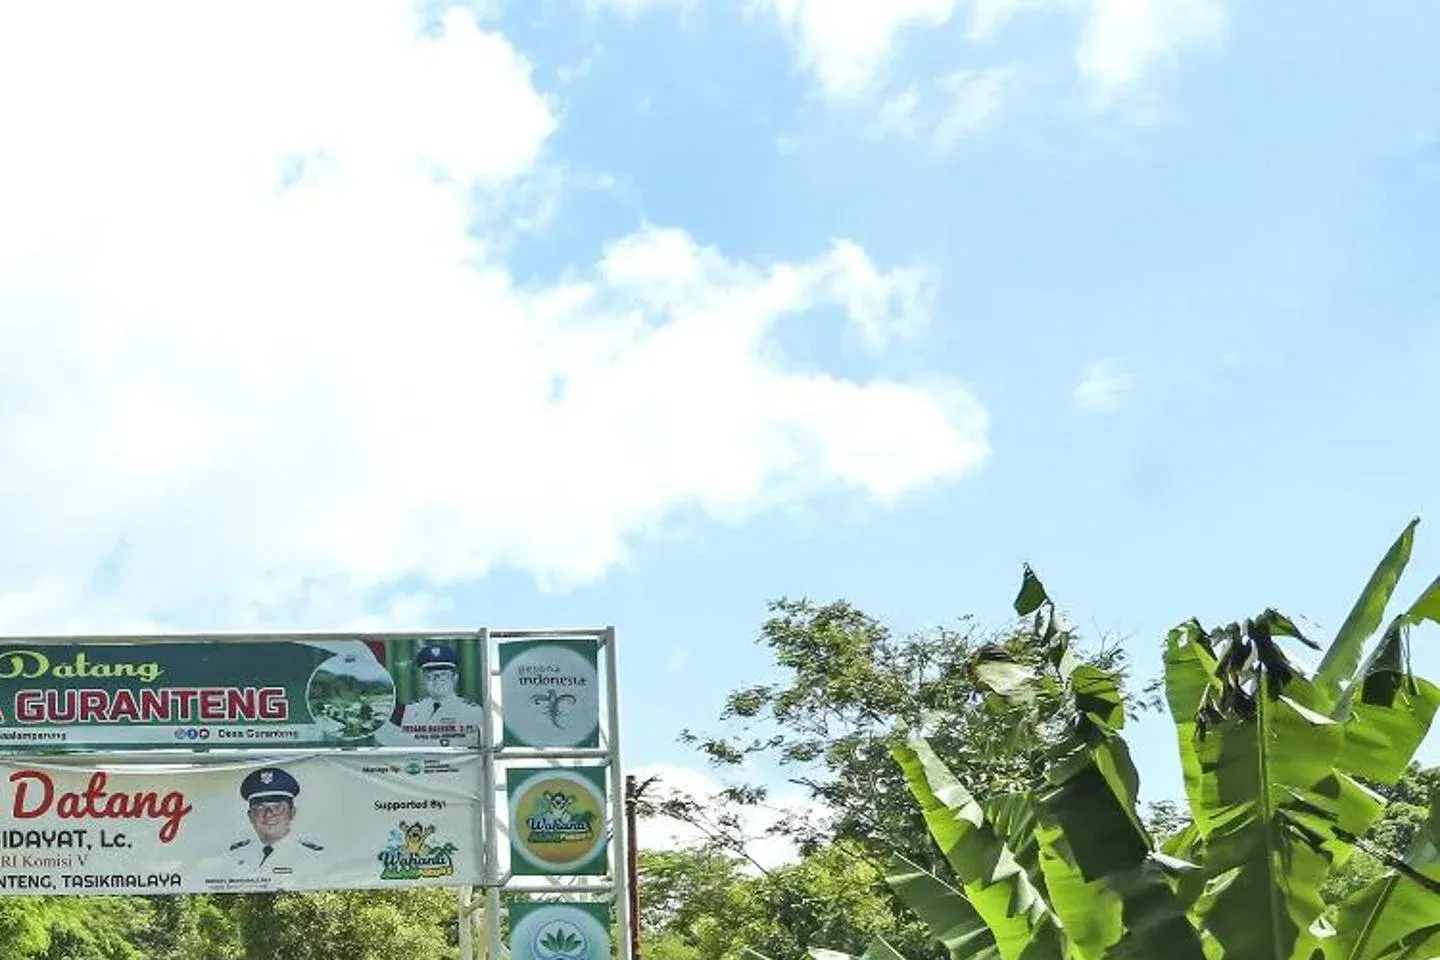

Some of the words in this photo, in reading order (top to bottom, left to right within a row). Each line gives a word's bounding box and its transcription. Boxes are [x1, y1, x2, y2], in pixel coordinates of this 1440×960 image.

[15, 687, 288, 723] GURANTENG
[8, 769, 193, 844] Datang
[374, 800, 427, 811] Supported
[100, 829, 133, 849] Lc.
[0, 854, 19, 868] RI
[22, 853, 72, 868] Komisi
[77, 853, 91, 867] V
[61, 873, 182, 889] TASIKMALAYA
